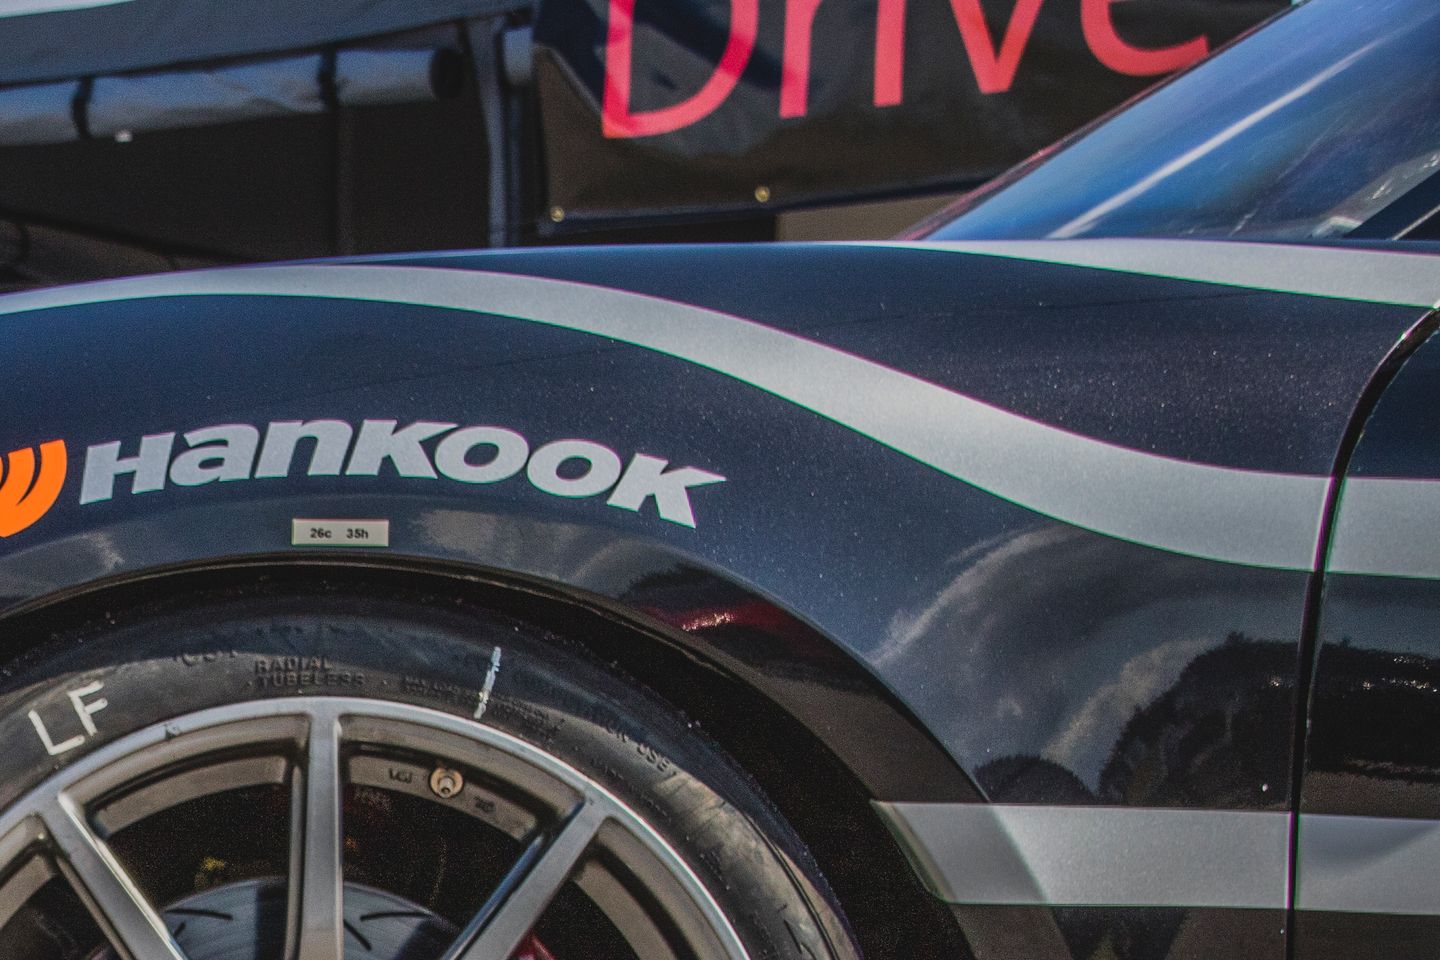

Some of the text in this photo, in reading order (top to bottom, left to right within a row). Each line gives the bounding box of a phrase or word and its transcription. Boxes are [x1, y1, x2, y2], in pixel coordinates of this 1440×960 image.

[309, 527, 369, 540] 26c 35h
[27, 680, 109, 756] LF
